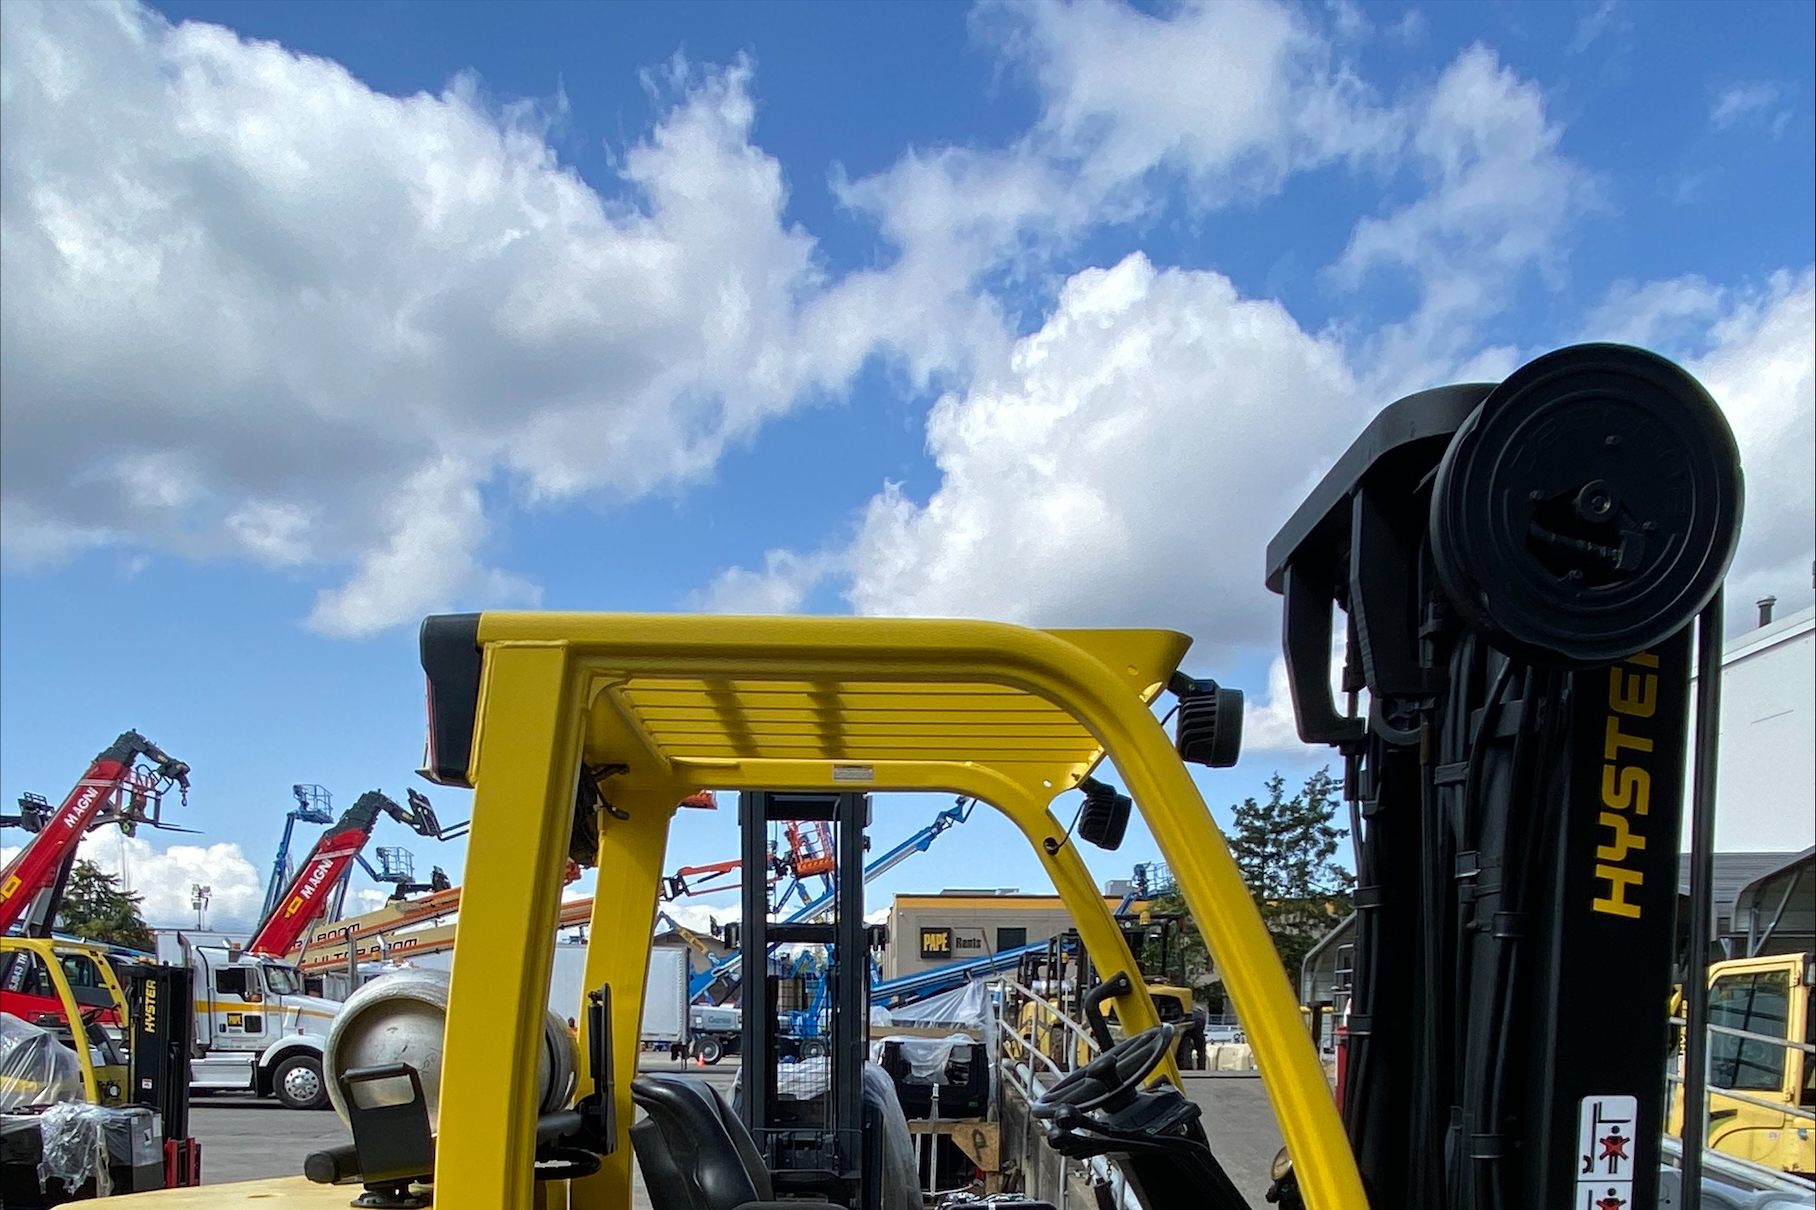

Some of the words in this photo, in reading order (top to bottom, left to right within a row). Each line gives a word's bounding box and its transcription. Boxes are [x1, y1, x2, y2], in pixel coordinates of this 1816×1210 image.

[63, 786, 99, 829] MAGNI
[300, 857, 334, 899] MAGNI
[955, 937, 982, 949] Rents
[144, 979, 157, 1034] HYSTER
